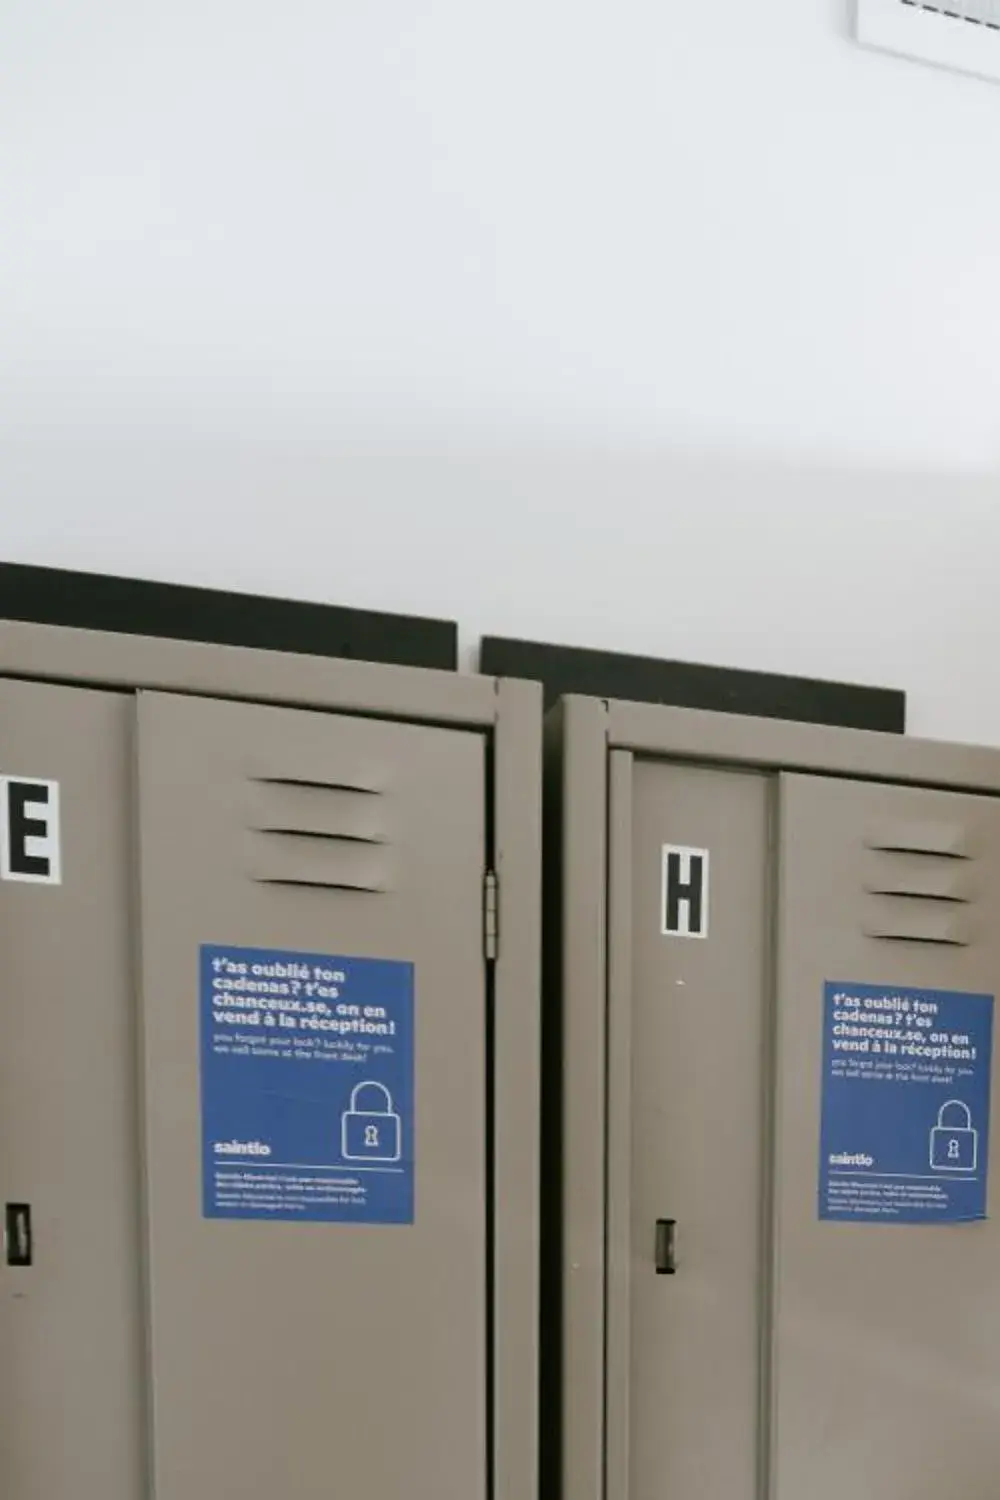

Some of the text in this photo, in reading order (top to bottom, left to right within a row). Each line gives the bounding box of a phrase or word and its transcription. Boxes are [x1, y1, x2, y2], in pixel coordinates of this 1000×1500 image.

[8, 781, 50, 876] E
[666, 852, 703, 933] H
[212, 958, 345, 982] t'as oublié ton
[305, 982, 339, 998] t'es
[213, 1011, 259, 1025] vend
[264, 1011, 275, 1026] à
[280, 1013, 297, 1027] la
[336, 1003, 358, 1015] on
[364, 1005, 385, 1018] en
